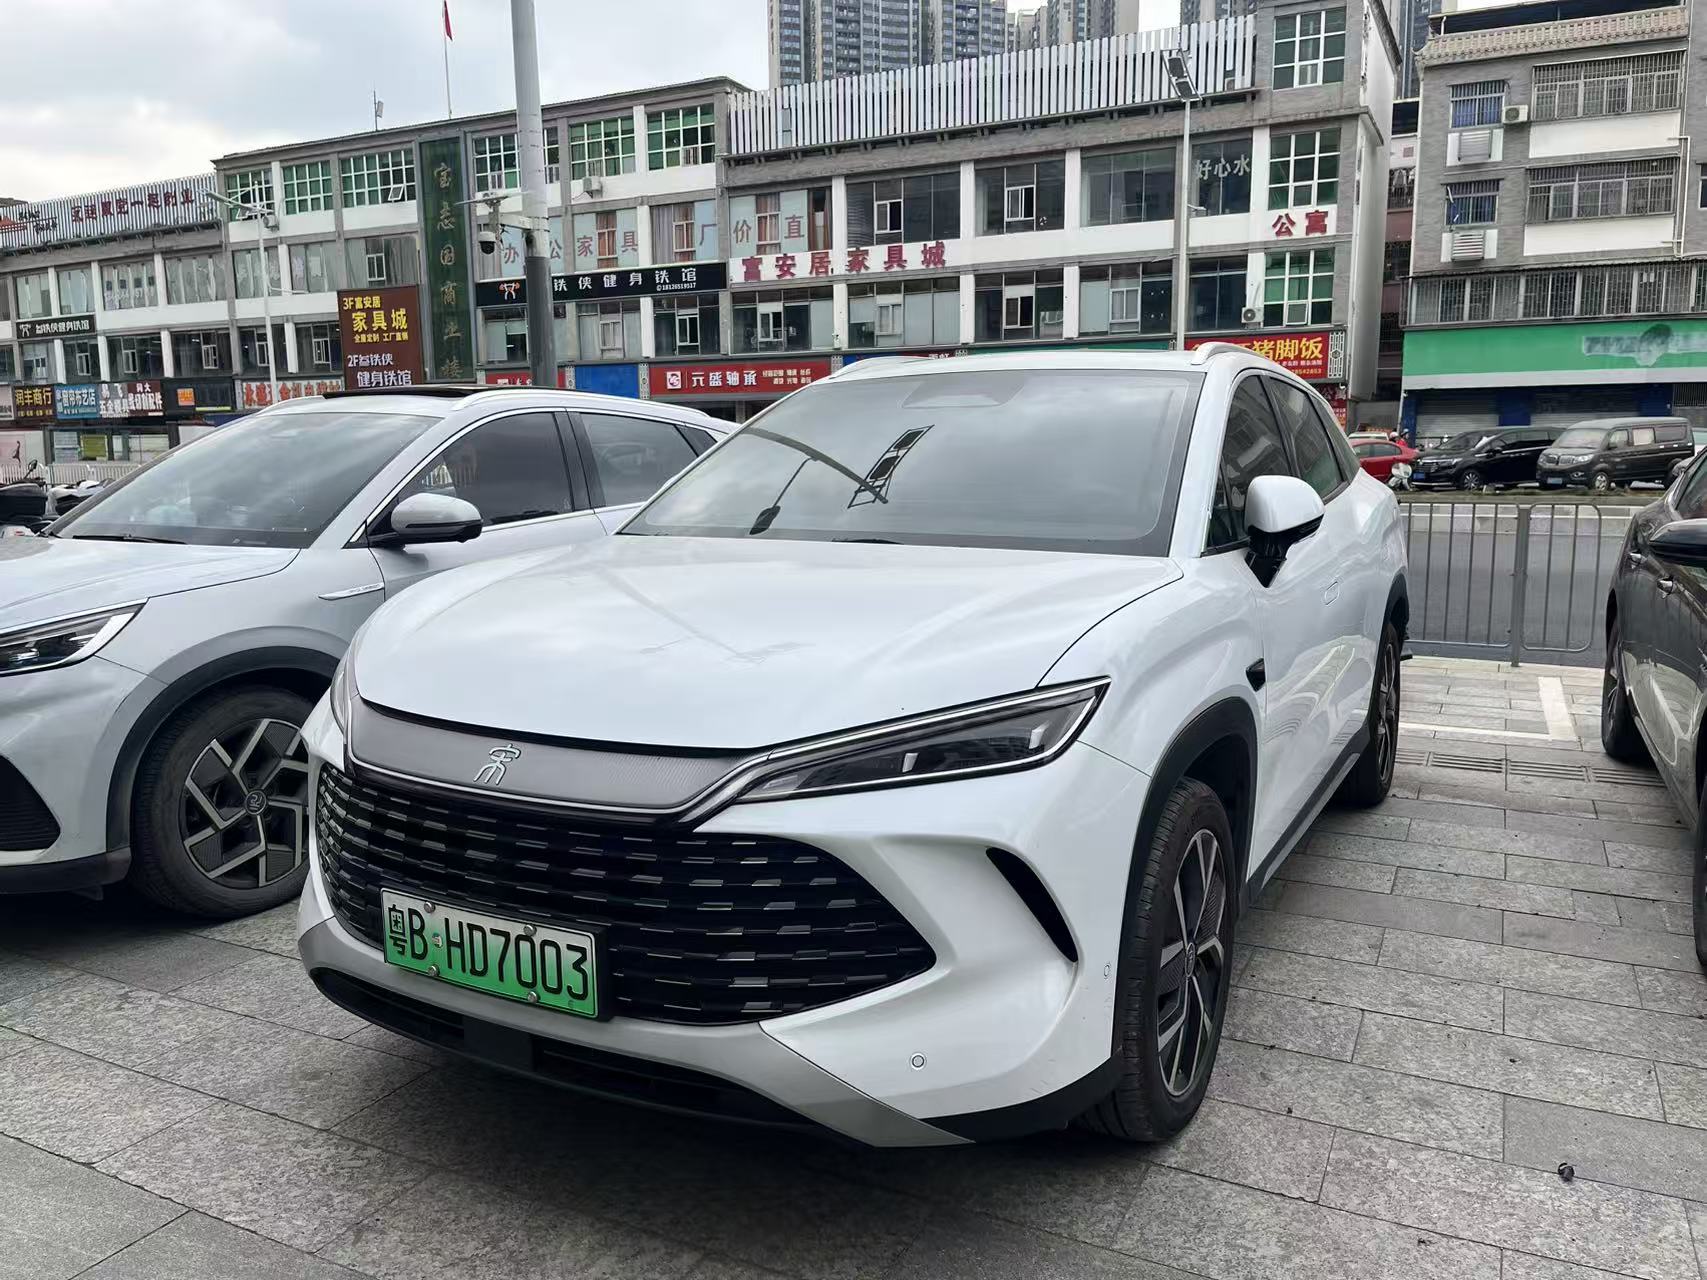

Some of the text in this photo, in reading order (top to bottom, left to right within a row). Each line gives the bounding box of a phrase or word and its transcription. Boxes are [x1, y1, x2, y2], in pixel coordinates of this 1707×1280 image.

[741, 240, 947, 281] 富安居家具城
[352, 308, 408, 332] 家具城
[1237, 336, 1324, 361] 猪脚饭
[356, 369, 412, 388] 健身铁馆
